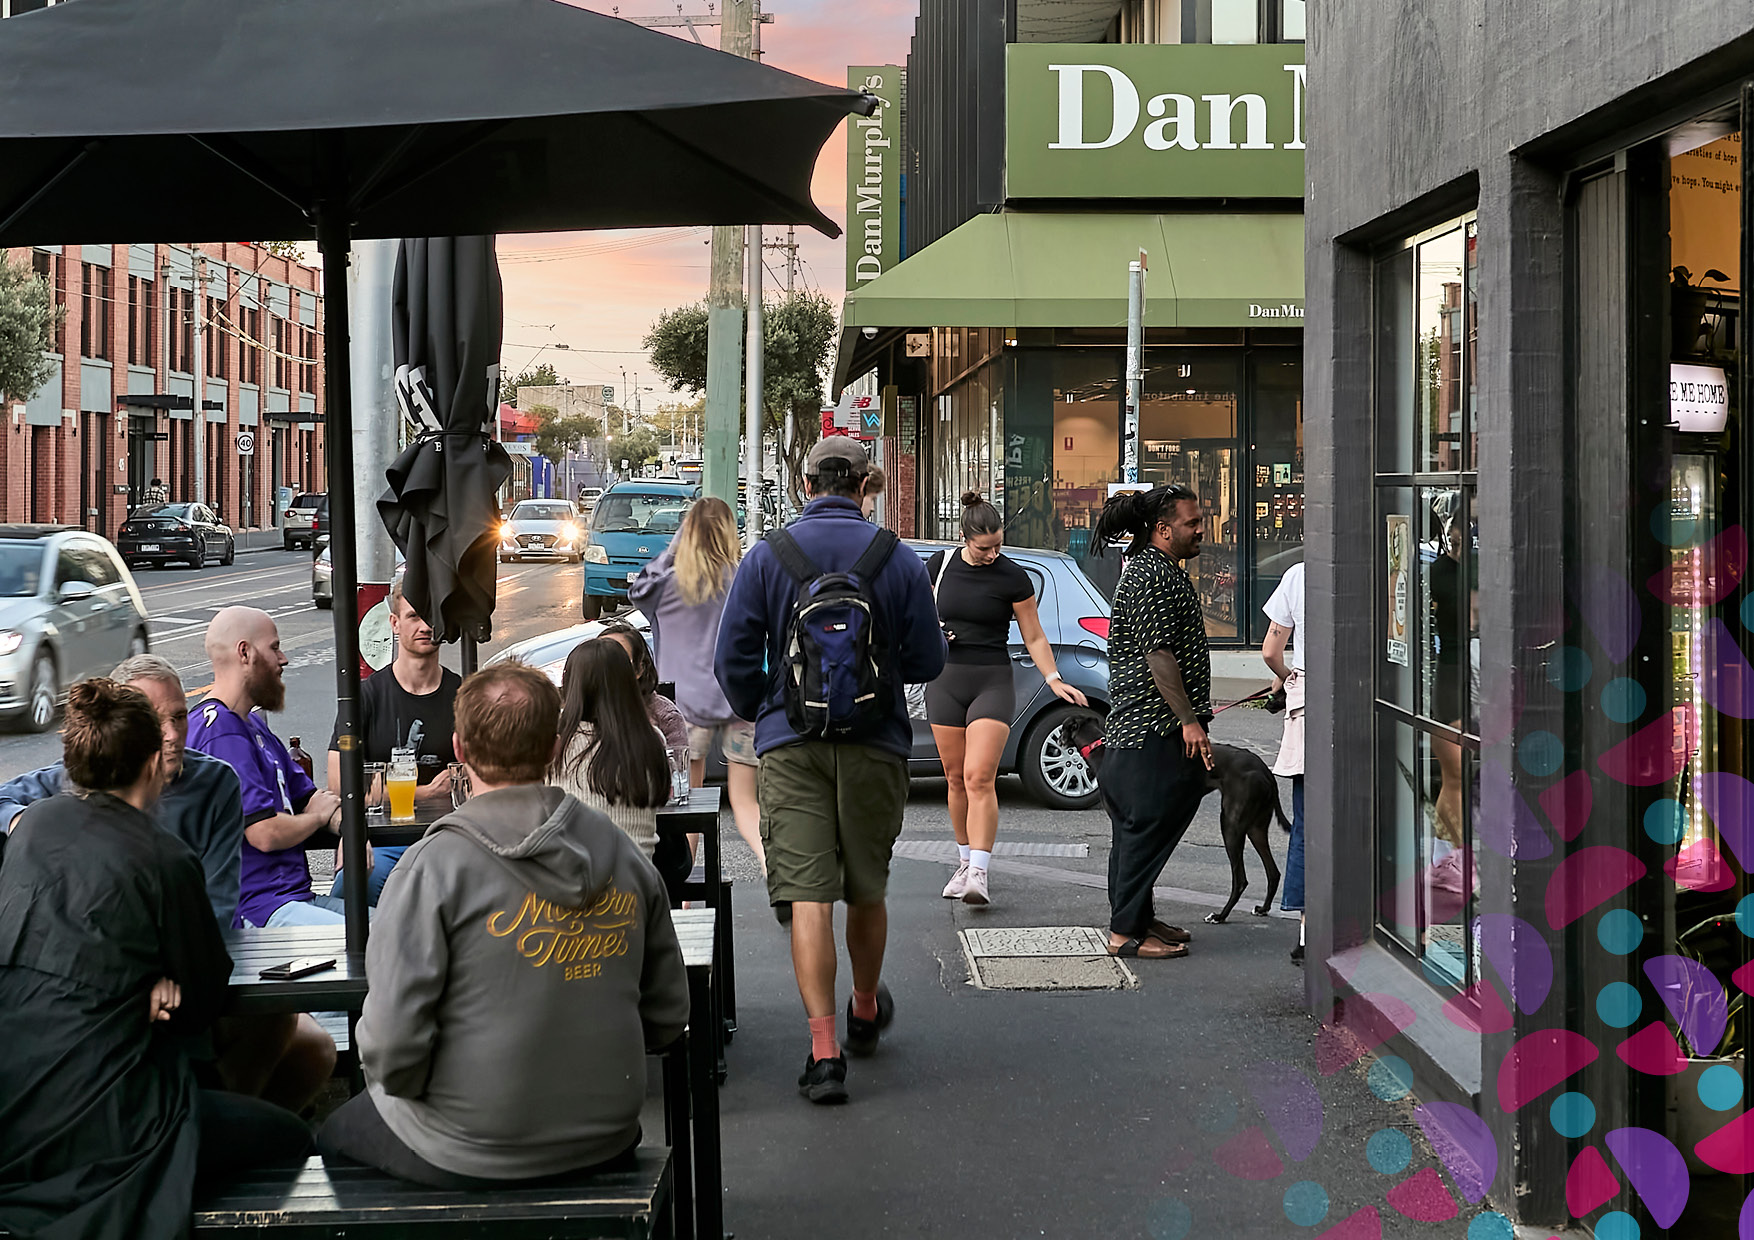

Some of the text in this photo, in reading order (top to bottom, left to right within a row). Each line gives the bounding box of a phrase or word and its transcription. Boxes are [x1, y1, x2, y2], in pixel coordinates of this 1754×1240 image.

[1723, 152, 1737, 165] hops
[1680, 382, 1696, 402] ME
[1697, 384, 1725, 404] HOME
[240, 439, 251, 448] 40
[517, 921, 629, 967] Times
[565, 963, 602, 981] BEER
